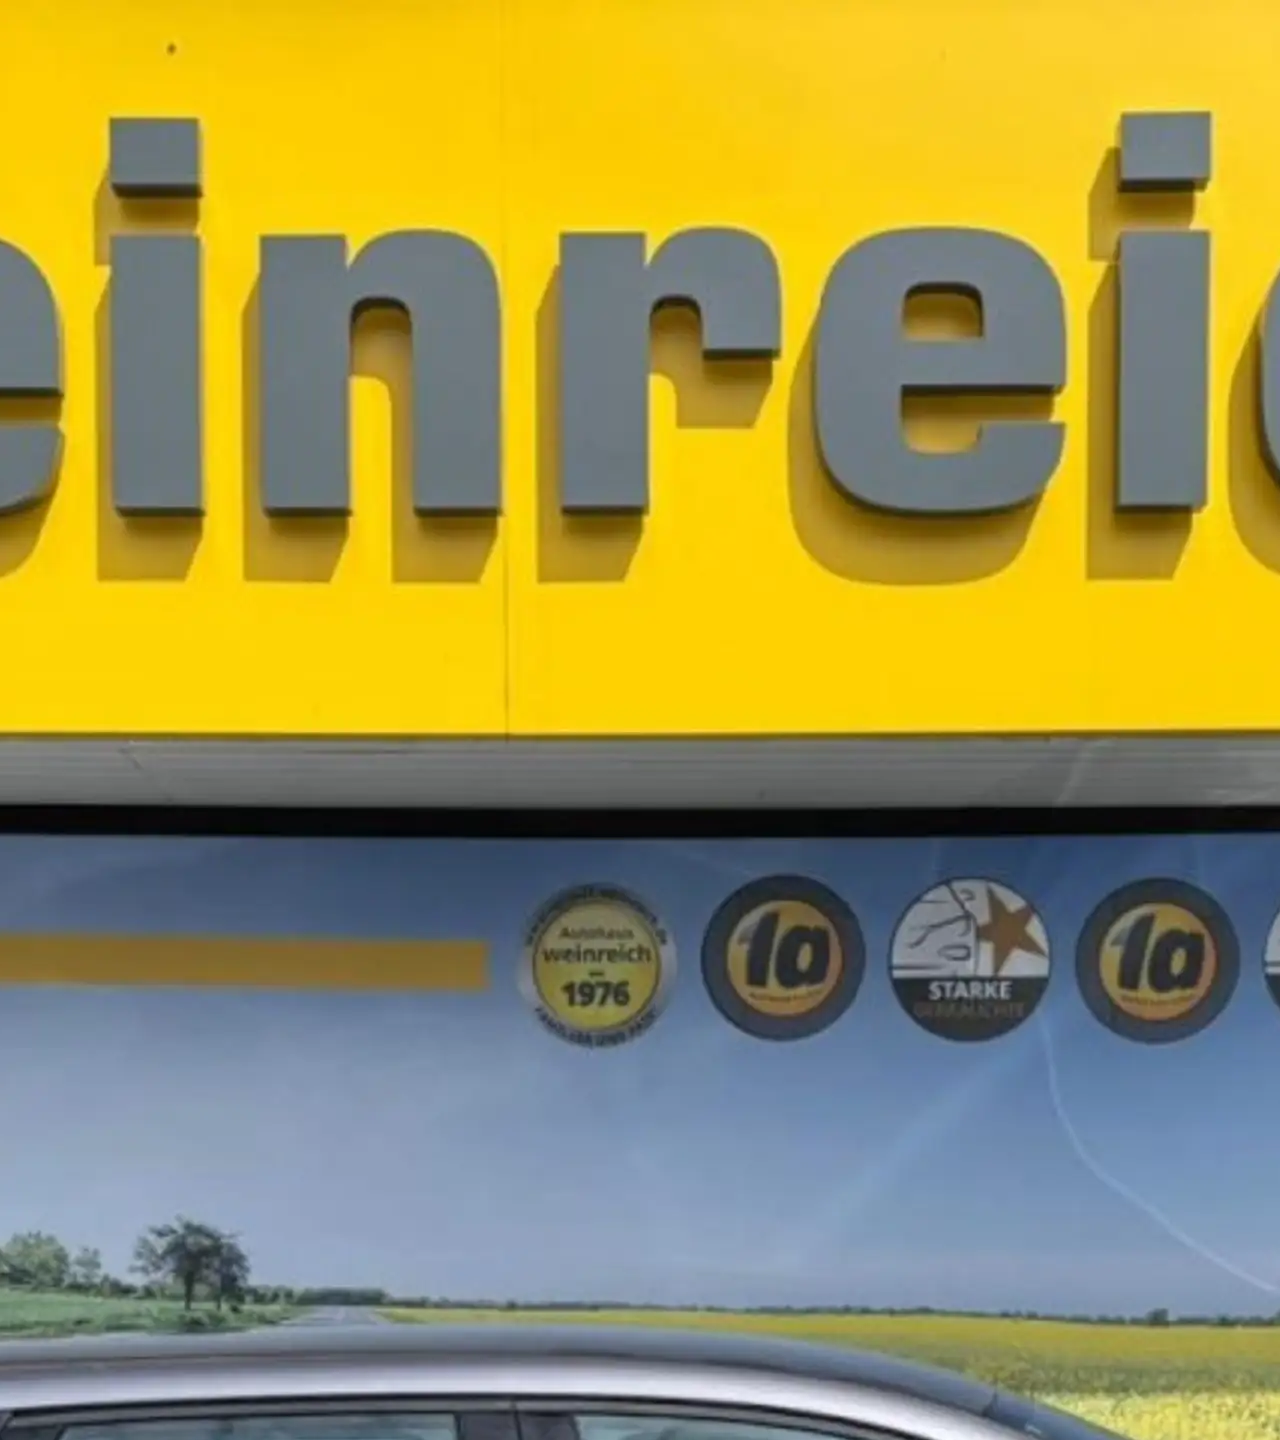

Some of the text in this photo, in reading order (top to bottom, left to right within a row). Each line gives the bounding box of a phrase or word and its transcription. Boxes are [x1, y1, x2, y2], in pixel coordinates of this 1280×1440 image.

[558, 926, 634, 940] Autohaus
[542, 944, 652, 963] weinreich
[561, 980, 631, 1008] 1976
[927, 980, 1013, 1000] STARKE
